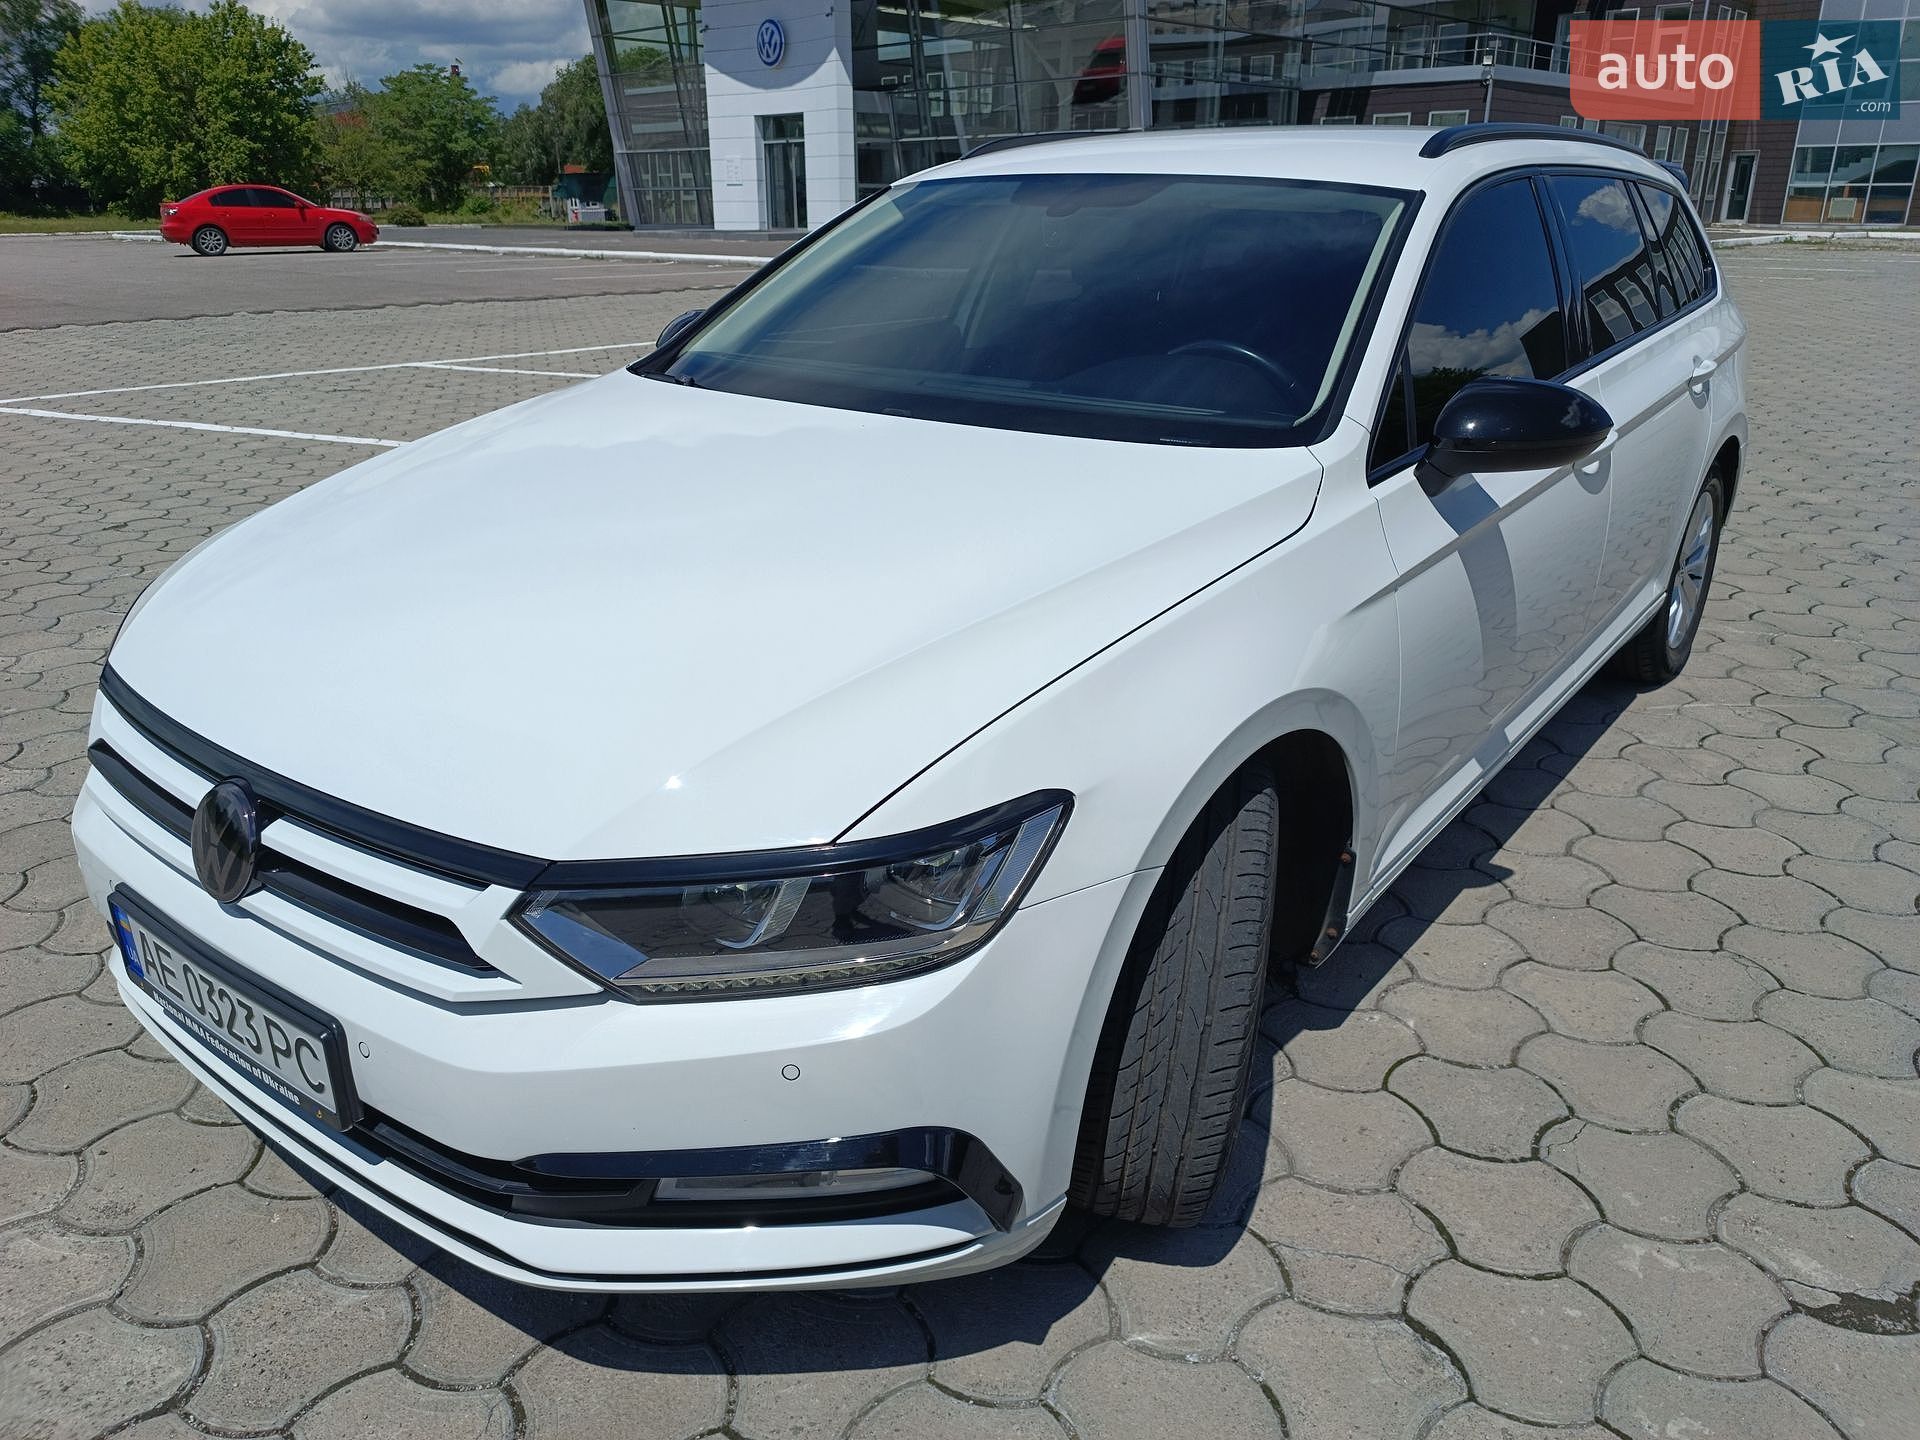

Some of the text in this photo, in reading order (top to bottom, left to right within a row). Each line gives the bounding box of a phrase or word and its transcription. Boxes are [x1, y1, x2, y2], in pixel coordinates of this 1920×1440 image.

[138, 929, 325, 1094] AE 0323 PC
[184, 1014, 207, 1040] MMA
[205, 1031, 252, 1074] Federation
[261, 1071, 300, 1105] Ukraine
